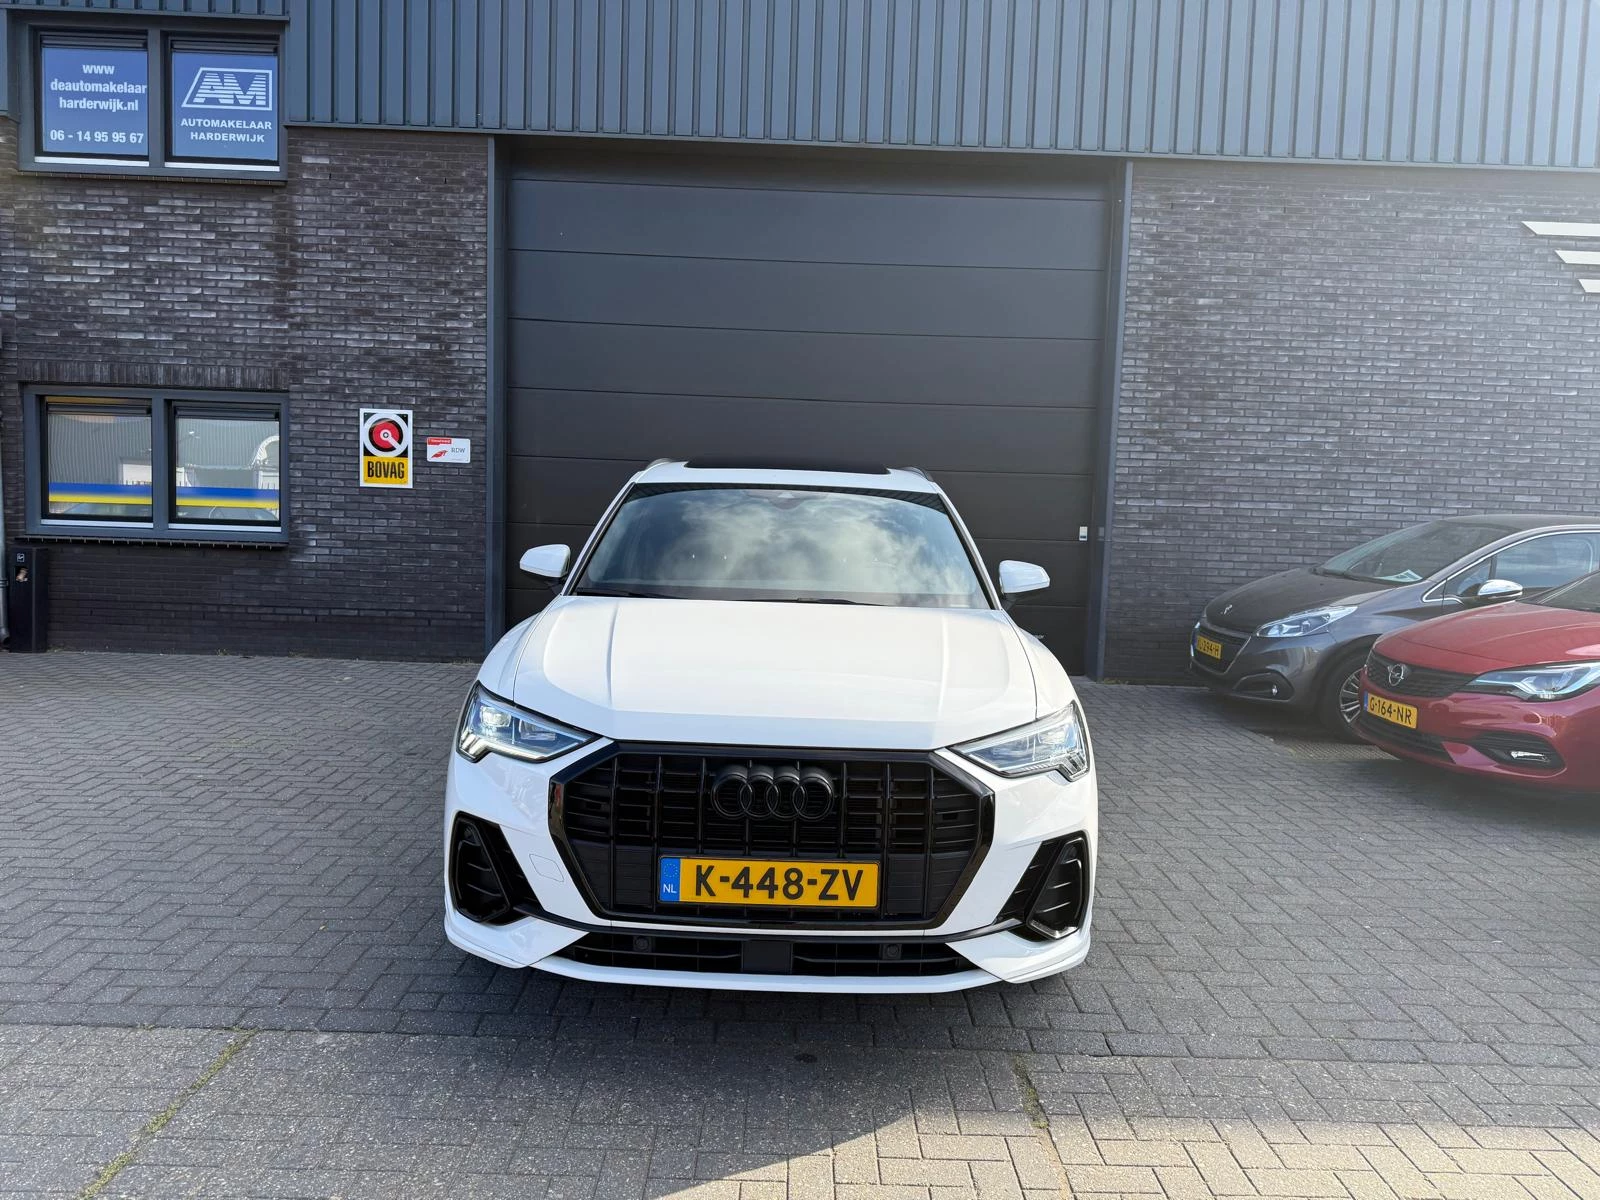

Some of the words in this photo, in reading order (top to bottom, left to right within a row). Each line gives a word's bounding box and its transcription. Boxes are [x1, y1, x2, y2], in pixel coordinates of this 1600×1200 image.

[82, 64, 115, 75] www
[50, 78, 148, 94] deautomakelaar
[192, 72, 267, 106] AM
[59, 96, 139, 113] harderwijk.nl
[180, 117, 273, 130] AUTOMAKELAAR
[50, 129, 65, 142] 06
[77, 131, 91, 142] 14
[93, 131, 109, 143] 95
[111, 132, 127, 143] 95
[129, 132, 144, 144] 67
[190, 131, 265, 143] HARDERWIJK
[367, 460, 405, 480] BOVAG
[1369, 697, 1412, 725] G-164-NR
[663, 883, 677, 894] NL
[695, 864, 864, 901] K-448-ZV
